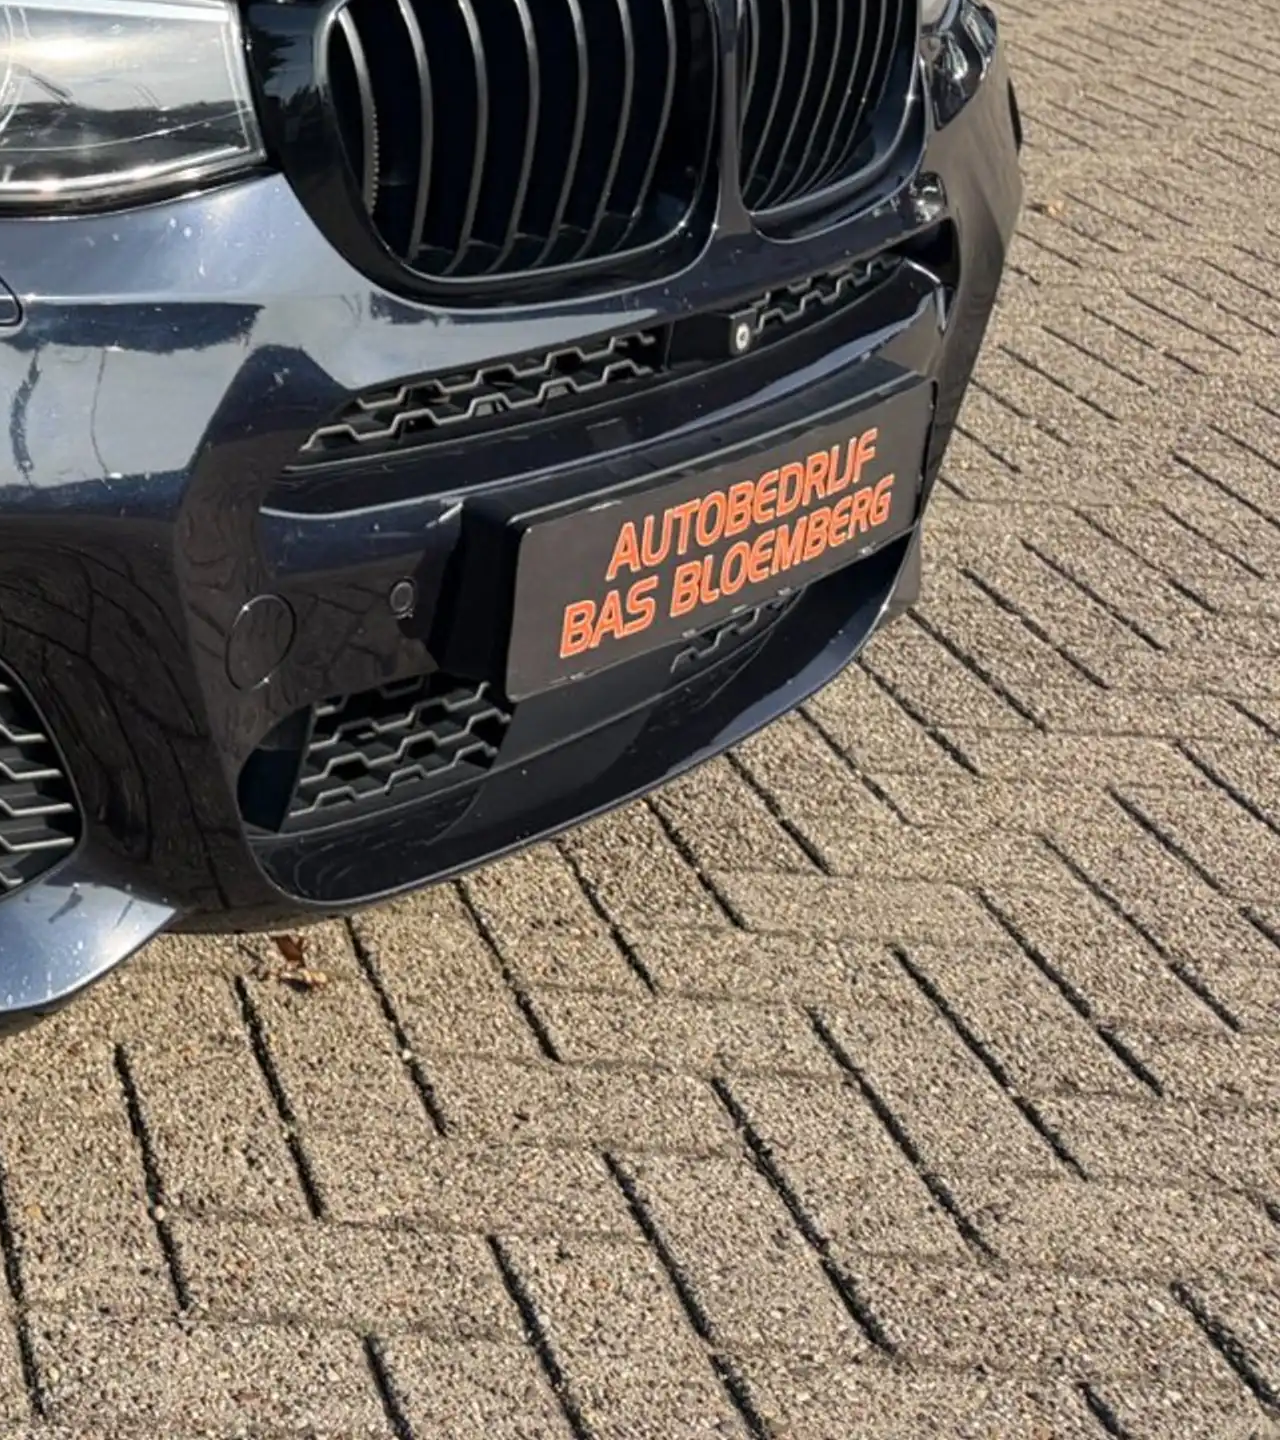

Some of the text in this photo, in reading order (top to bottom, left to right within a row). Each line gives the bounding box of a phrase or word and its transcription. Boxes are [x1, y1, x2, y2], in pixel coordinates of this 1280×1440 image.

[559, 473, 895, 659] BAS BLOEMBERG
[605, 427, 879, 582] AUTOBEDRIJF
